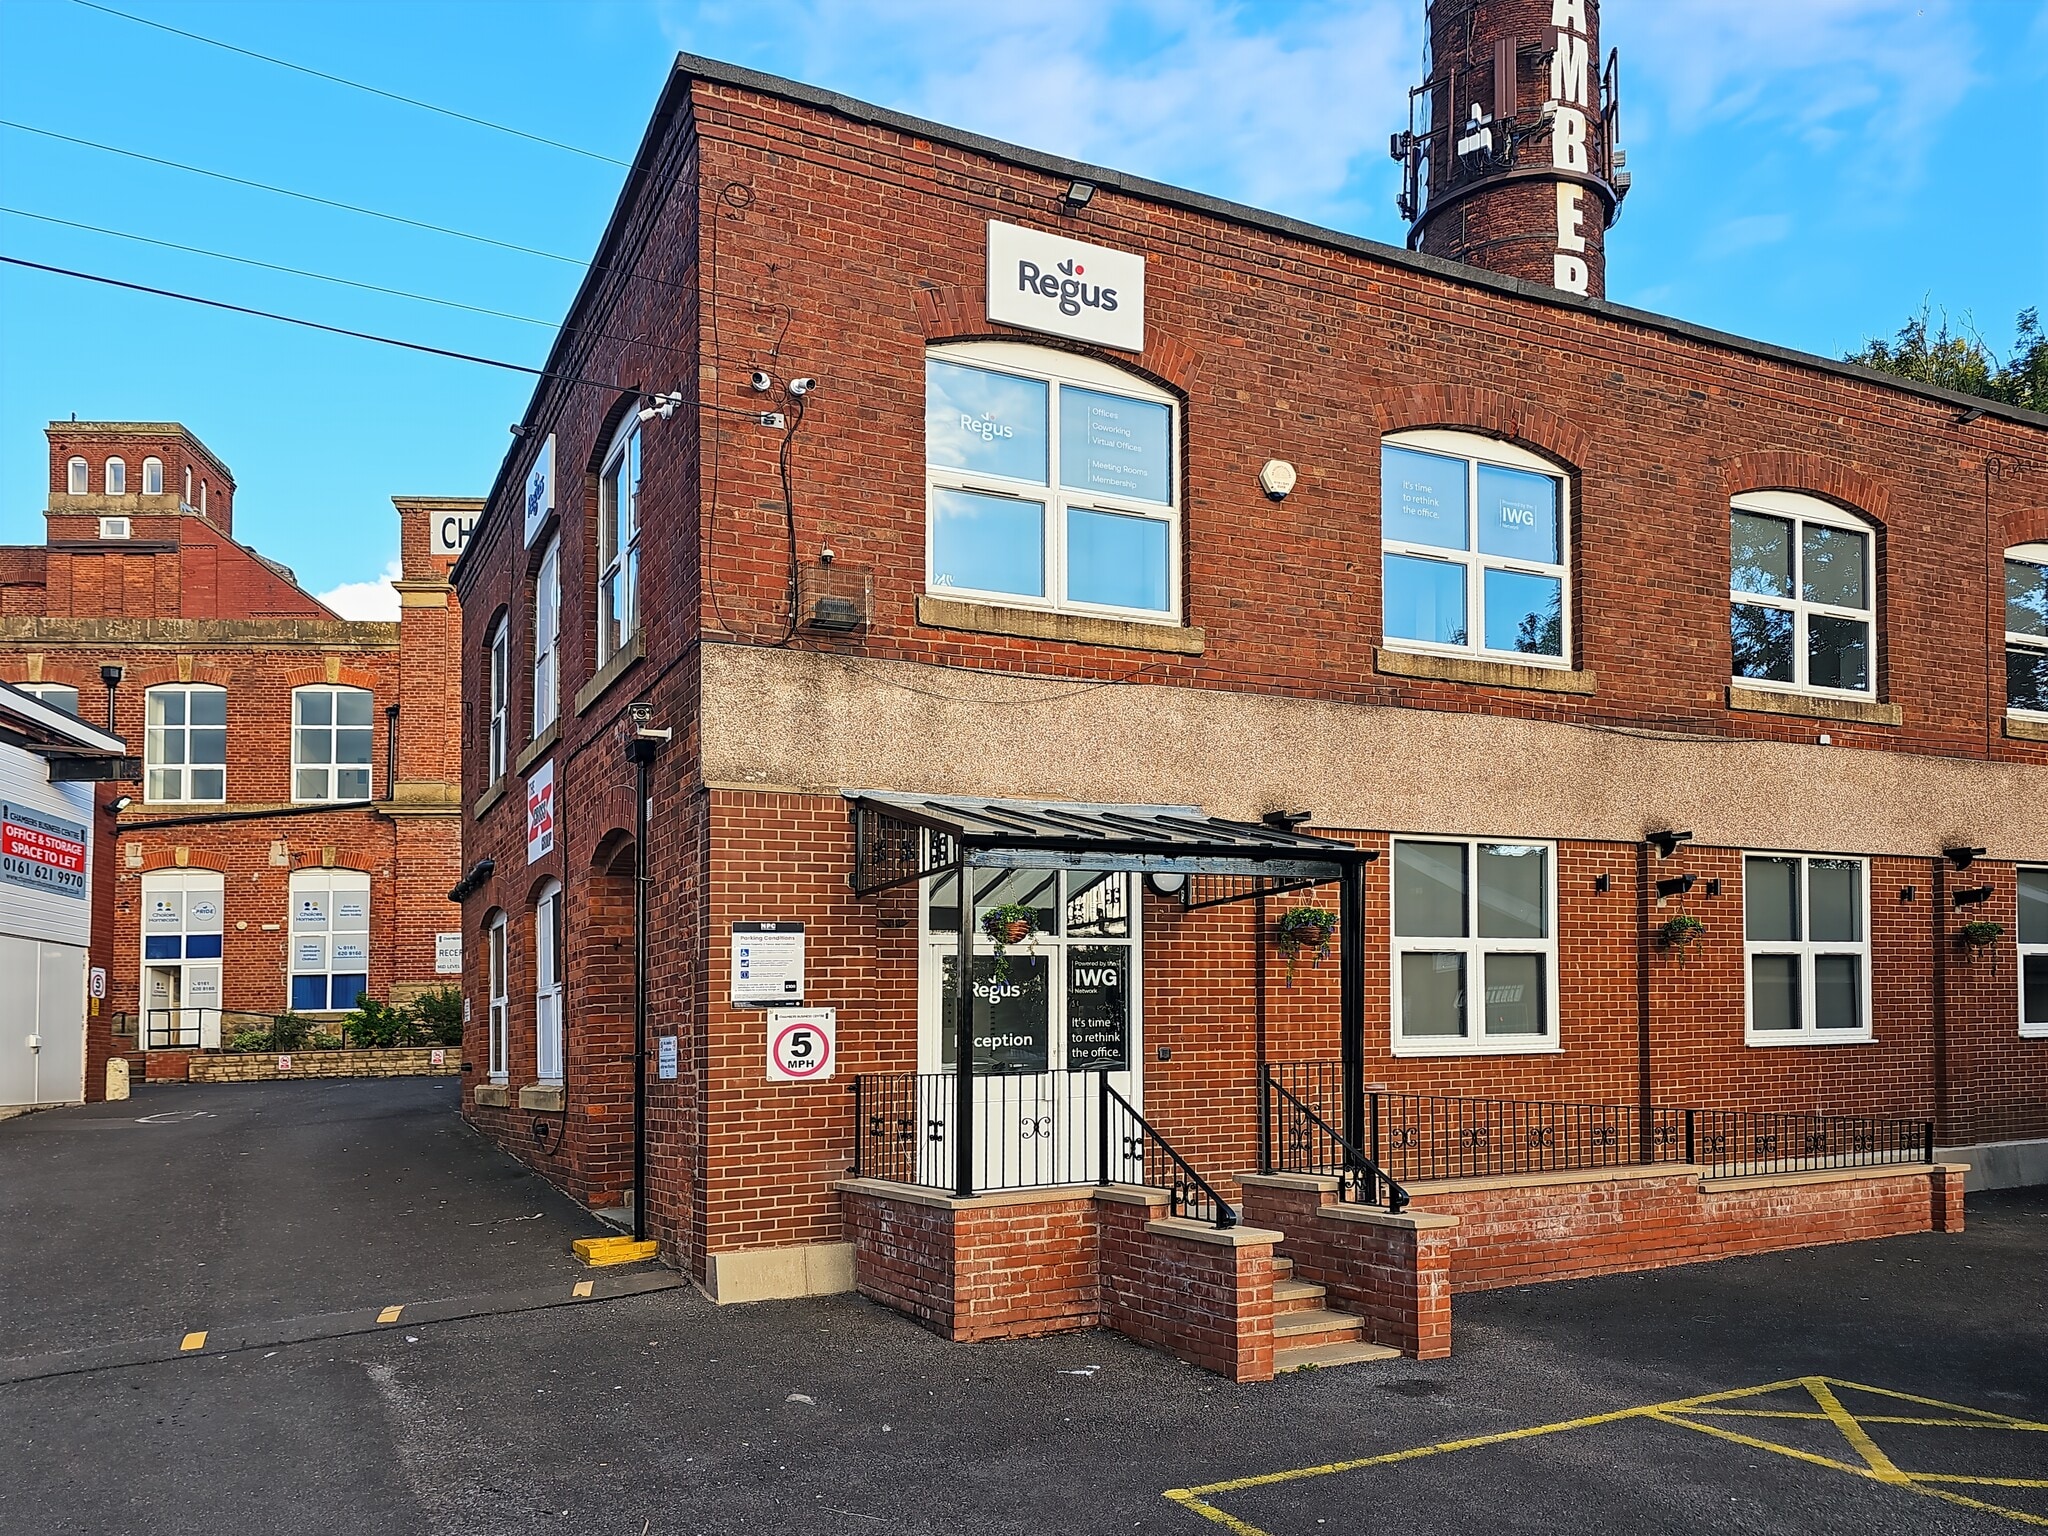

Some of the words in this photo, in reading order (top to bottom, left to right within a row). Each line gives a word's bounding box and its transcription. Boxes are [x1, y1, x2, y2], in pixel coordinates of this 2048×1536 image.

[1019, 259, 1118, 316] Regus
[1092, 408, 1118, 419] Offices
[960, 412, 1013, 440] Regus
[1092, 422, 1130, 437] Coworking
[1092, 436, 1115, 447] Virtual
[1116, 442, 1142, 452] Offices
[1092, 460, 1122, 474] Meeting
[1123, 466, 1148, 476] Rooms
[1092, 475, 1136, 490] Membership
[1402, 480, 1414, 490] It's
[1415, 483, 1432, 494] time
[1403, 494, 1411, 502] to
[1412, 496, 1440, 507] rethink
[1403, 505, 1416, 514] the
[1418, 508, 1440, 519] office.
[1503, 507, 1534, 526] IWG
[6, 825, 37, 843] OFFICE
[38, 834, 44, 845] &
[46, 836, 82, 856] STORAGE
[11, 841, 42, 860] SPACE
[44, 850, 58, 864] TO
[60, 854, 78, 868] LET
[4, 858, 30, 876] 0161
[34, 865, 52, 880] 621
[58, 871, 83, 888] 9970
[95, 978, 101, 989] 5
[1075, 968, 1117, 986] IWG
[1072, 1018, 1086, 1028] It's
[1088, 1018, 1111, 1028] time
[790, 1031, 812, 1058] 5
[954, 1033, 1032, 1050] ception
[1072, 1033, 1082, 1042] to
[1085, 1032, 1120, 1042] rethink
[1072, 1047, 1089, 1058] the
[1091, 1046, 1121, 1057] office.
[788, 1060, 814, 1068] MPH
